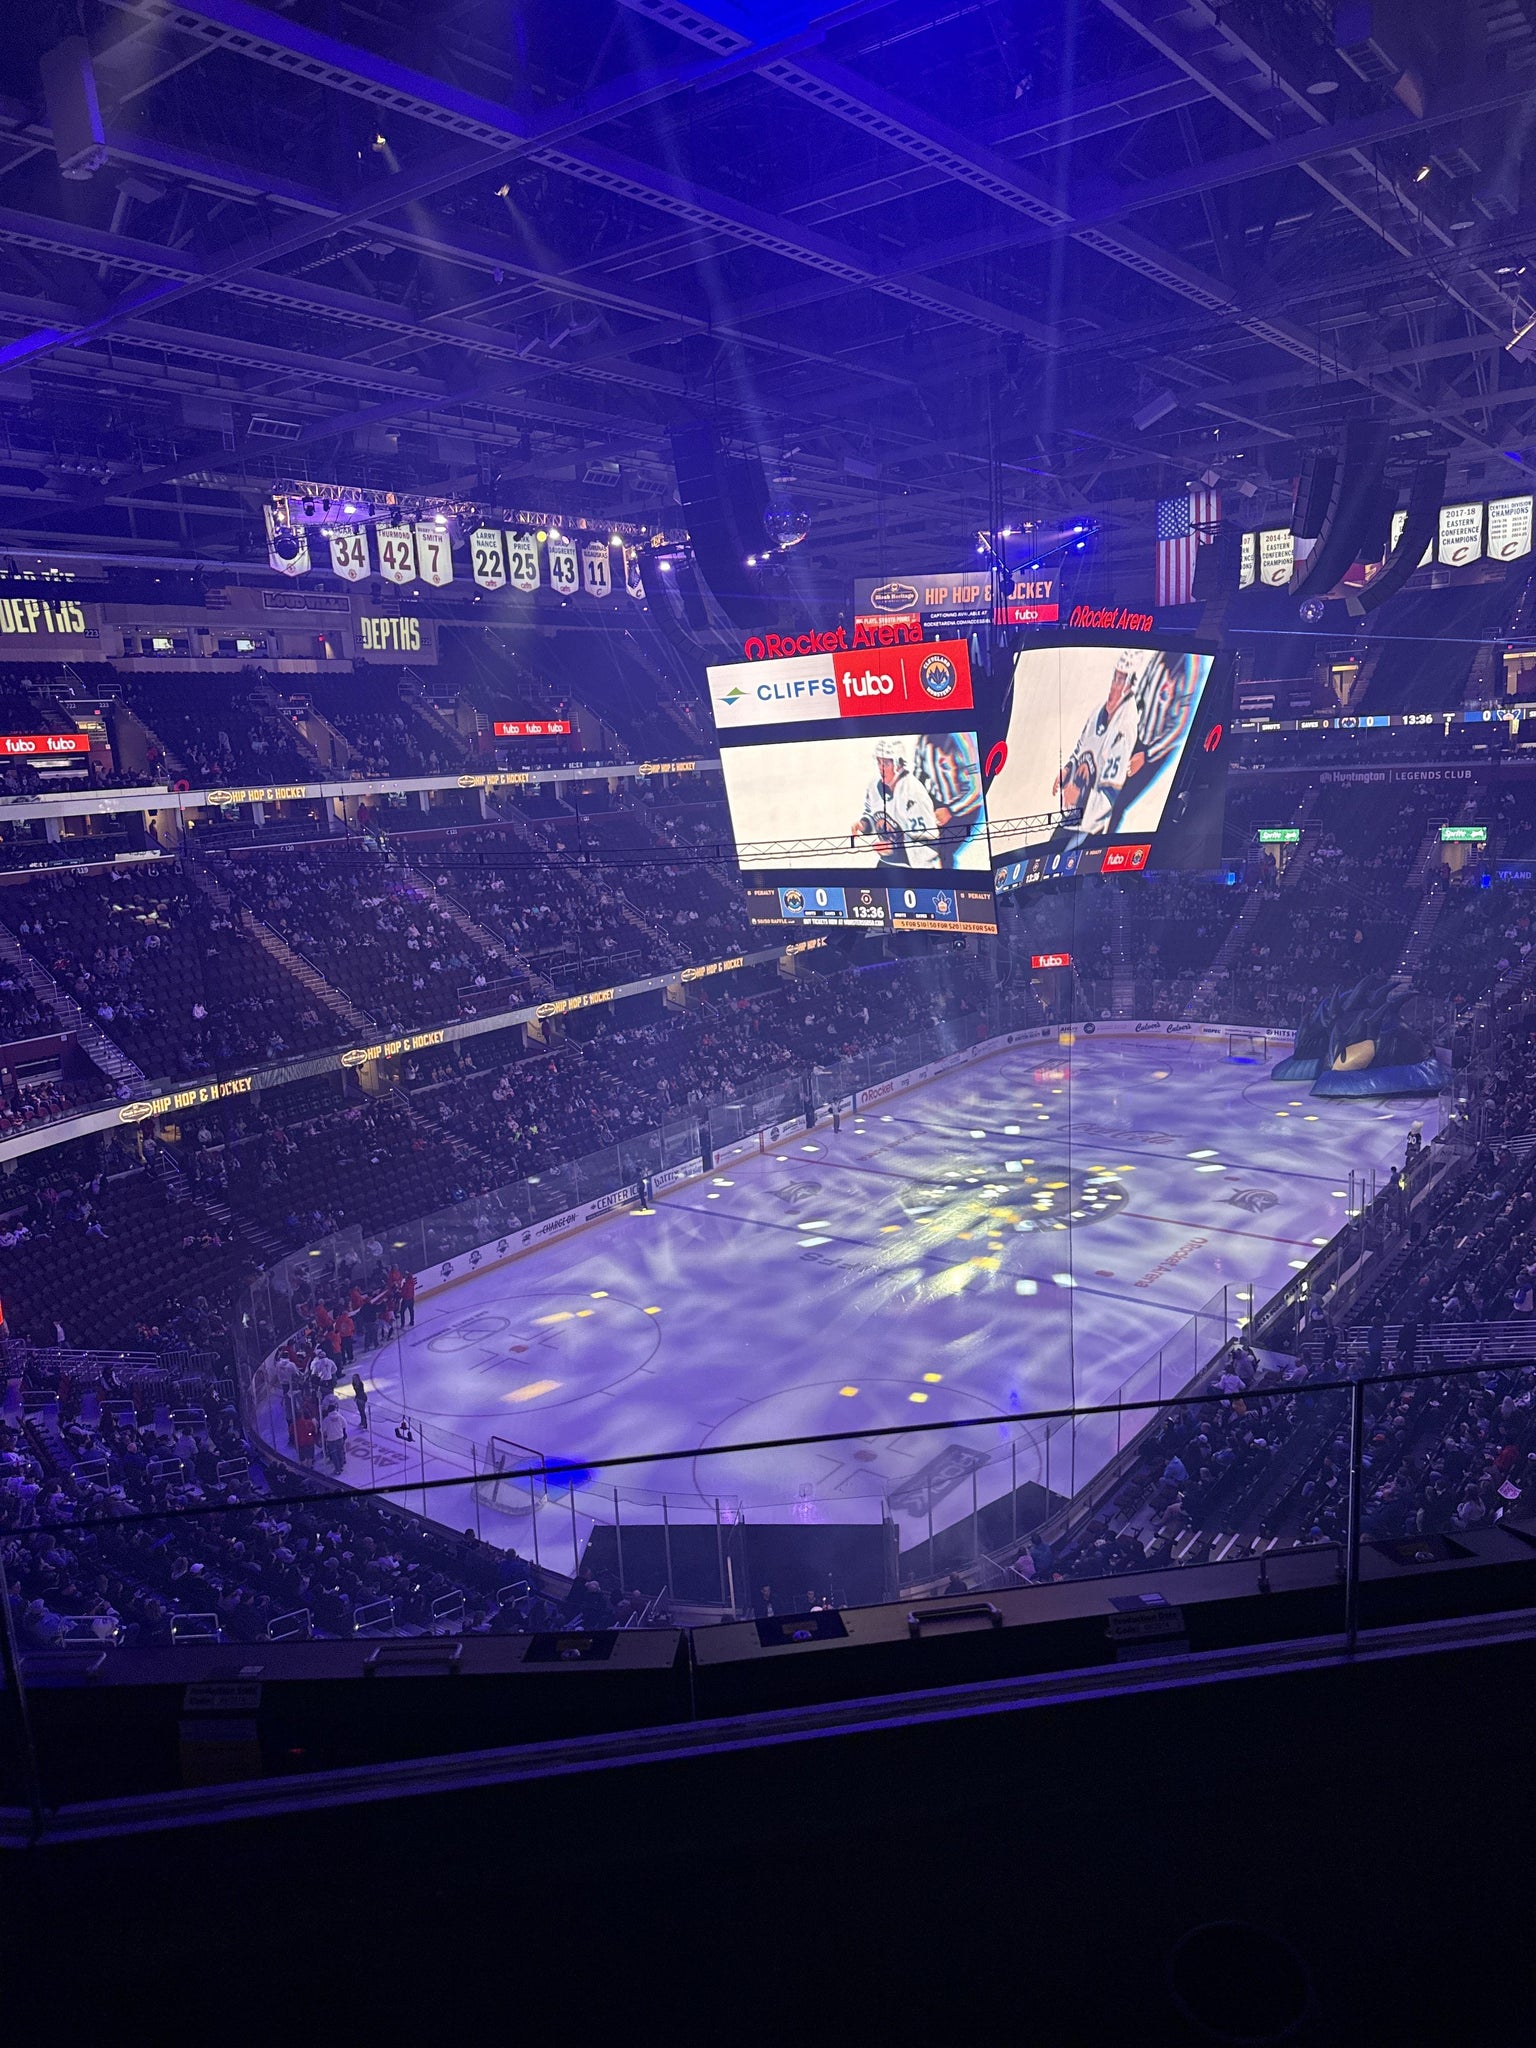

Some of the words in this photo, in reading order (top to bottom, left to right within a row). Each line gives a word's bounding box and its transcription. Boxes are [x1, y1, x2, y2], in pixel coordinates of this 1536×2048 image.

[1446, 508, 1476, 518] 2017-18
[1490, 504, 1510, 512] CENTRAL
[1491, 507, 1529, 518] CHAMPIONS
[1447, 518, 1474, 528] EASTERN
[422, 534, 443, 543] SMITH
[476, 532, 496, 540] LARRY
[1441, 526, 1480, 537] CONFERENCE
[476, 540, 497, 548] NANCE
[513, 543, 531, 551] PRICE
[1266, 543, 1290, 551] EASTERN
[1442, 535, 1478, 545] CHAMPIONS
[335, 538, 365, 568] 34
[383, 541, 411, 571] 42
[428, 545, 439, 573] 7
[475, 550, 502, 577] 22
[512, 552, 537, 580] 25
[553, 556, 575, 583] 43
[1263, 558, 1293, 567] CHAMPIONS
[588, 561, 606, 586] 11
[925, 587, 948, 605] HIP
[952, 586, 976, 604] HOP
[1008, 580, 1053, 601] OCKEY
[1015, 609, 1039, 621] fubo
[1078, 605, 1119, 629] Rocket
[1115, 608, 1153, 632] Arena
[85, 630, 99, 638] 223
[361, 617, 421, 650] DEPTHS
[766, 626, 848, 659] Rocket
[853, 622, 923, 649] Arena
[757, 678, 836, 701] CLIFFS
[843, 671, 894, 698] fubo
[1366, 716, 1374, 727] 0
[1402, 713, 1433, 725] 13:36
[1482, 710, 1492, 721] 0
[503, 724, 520, 734] fubo
[525, 723, 542, 733] fubo
[547, 722, 563, 733] fubo
[1322, 720, 1329, 728] 0
[6, 738, 35, 752] fubo
[46, 736, 76, 751] fubo
[676, 762, 695, 772] HOCKEY
[1103, 757, 1121, 778] 25
[474, 776, 486, 785] HIP
[487, 775, 499, 784] HOP
[506, 773, 529, 783] HOCKEY
[1333, 771, 1385, 783] Huntington
[1396, 771, 1441, 780] LEGENDS
[1444, 770, 1472, 779] CLUB
[231, 791, 246, 802] HIP
[248, 789, 265, 801] HOP
[267, 788, 273, 799] &
[276, 787, 306, 799] HOCKEY
[1052, 854, 1061, 871] 0
[1107, 853, 1124, 865] fubo
[1012, 863, 1021, 880] 0
[815, 888, 828, 906] 0
[904, 890, 916, 908] 0
[853, 907, 884, 918] 13:36
[723, 957, 744, 971] HOCKEY
[1038, 955, 1063, 967] fubo
[555, 1001, 567, 1012] HIP
[568, 998, 581, 1010] HOP
[589, 988, 614, 1004] HOCKEY
[1273, 1029, 1290, 1037] HITS
[367, 1046, 382, 1060] HIP
[384, 1041, 401, 1056] HOP
[403, 1040, 410, 1051] &
[412, 1031, 444, 1049] HOCKEY
[152, 1099, 171, 1114] HIP
[174, 1091, 196, 1109] HOP
[200, 1088, 208, 1102] &
[211, 1077, 252, 1099] HOCKEY
[868, 1081, 894, 1100] Rocket
[597, 1188, 627, 1209] CENTER
[627, 1186, 640, 1199] IC
[1165, 1242, 1203, 1267] Rocket
[1134, 1263, 1172, 1288] Arena
